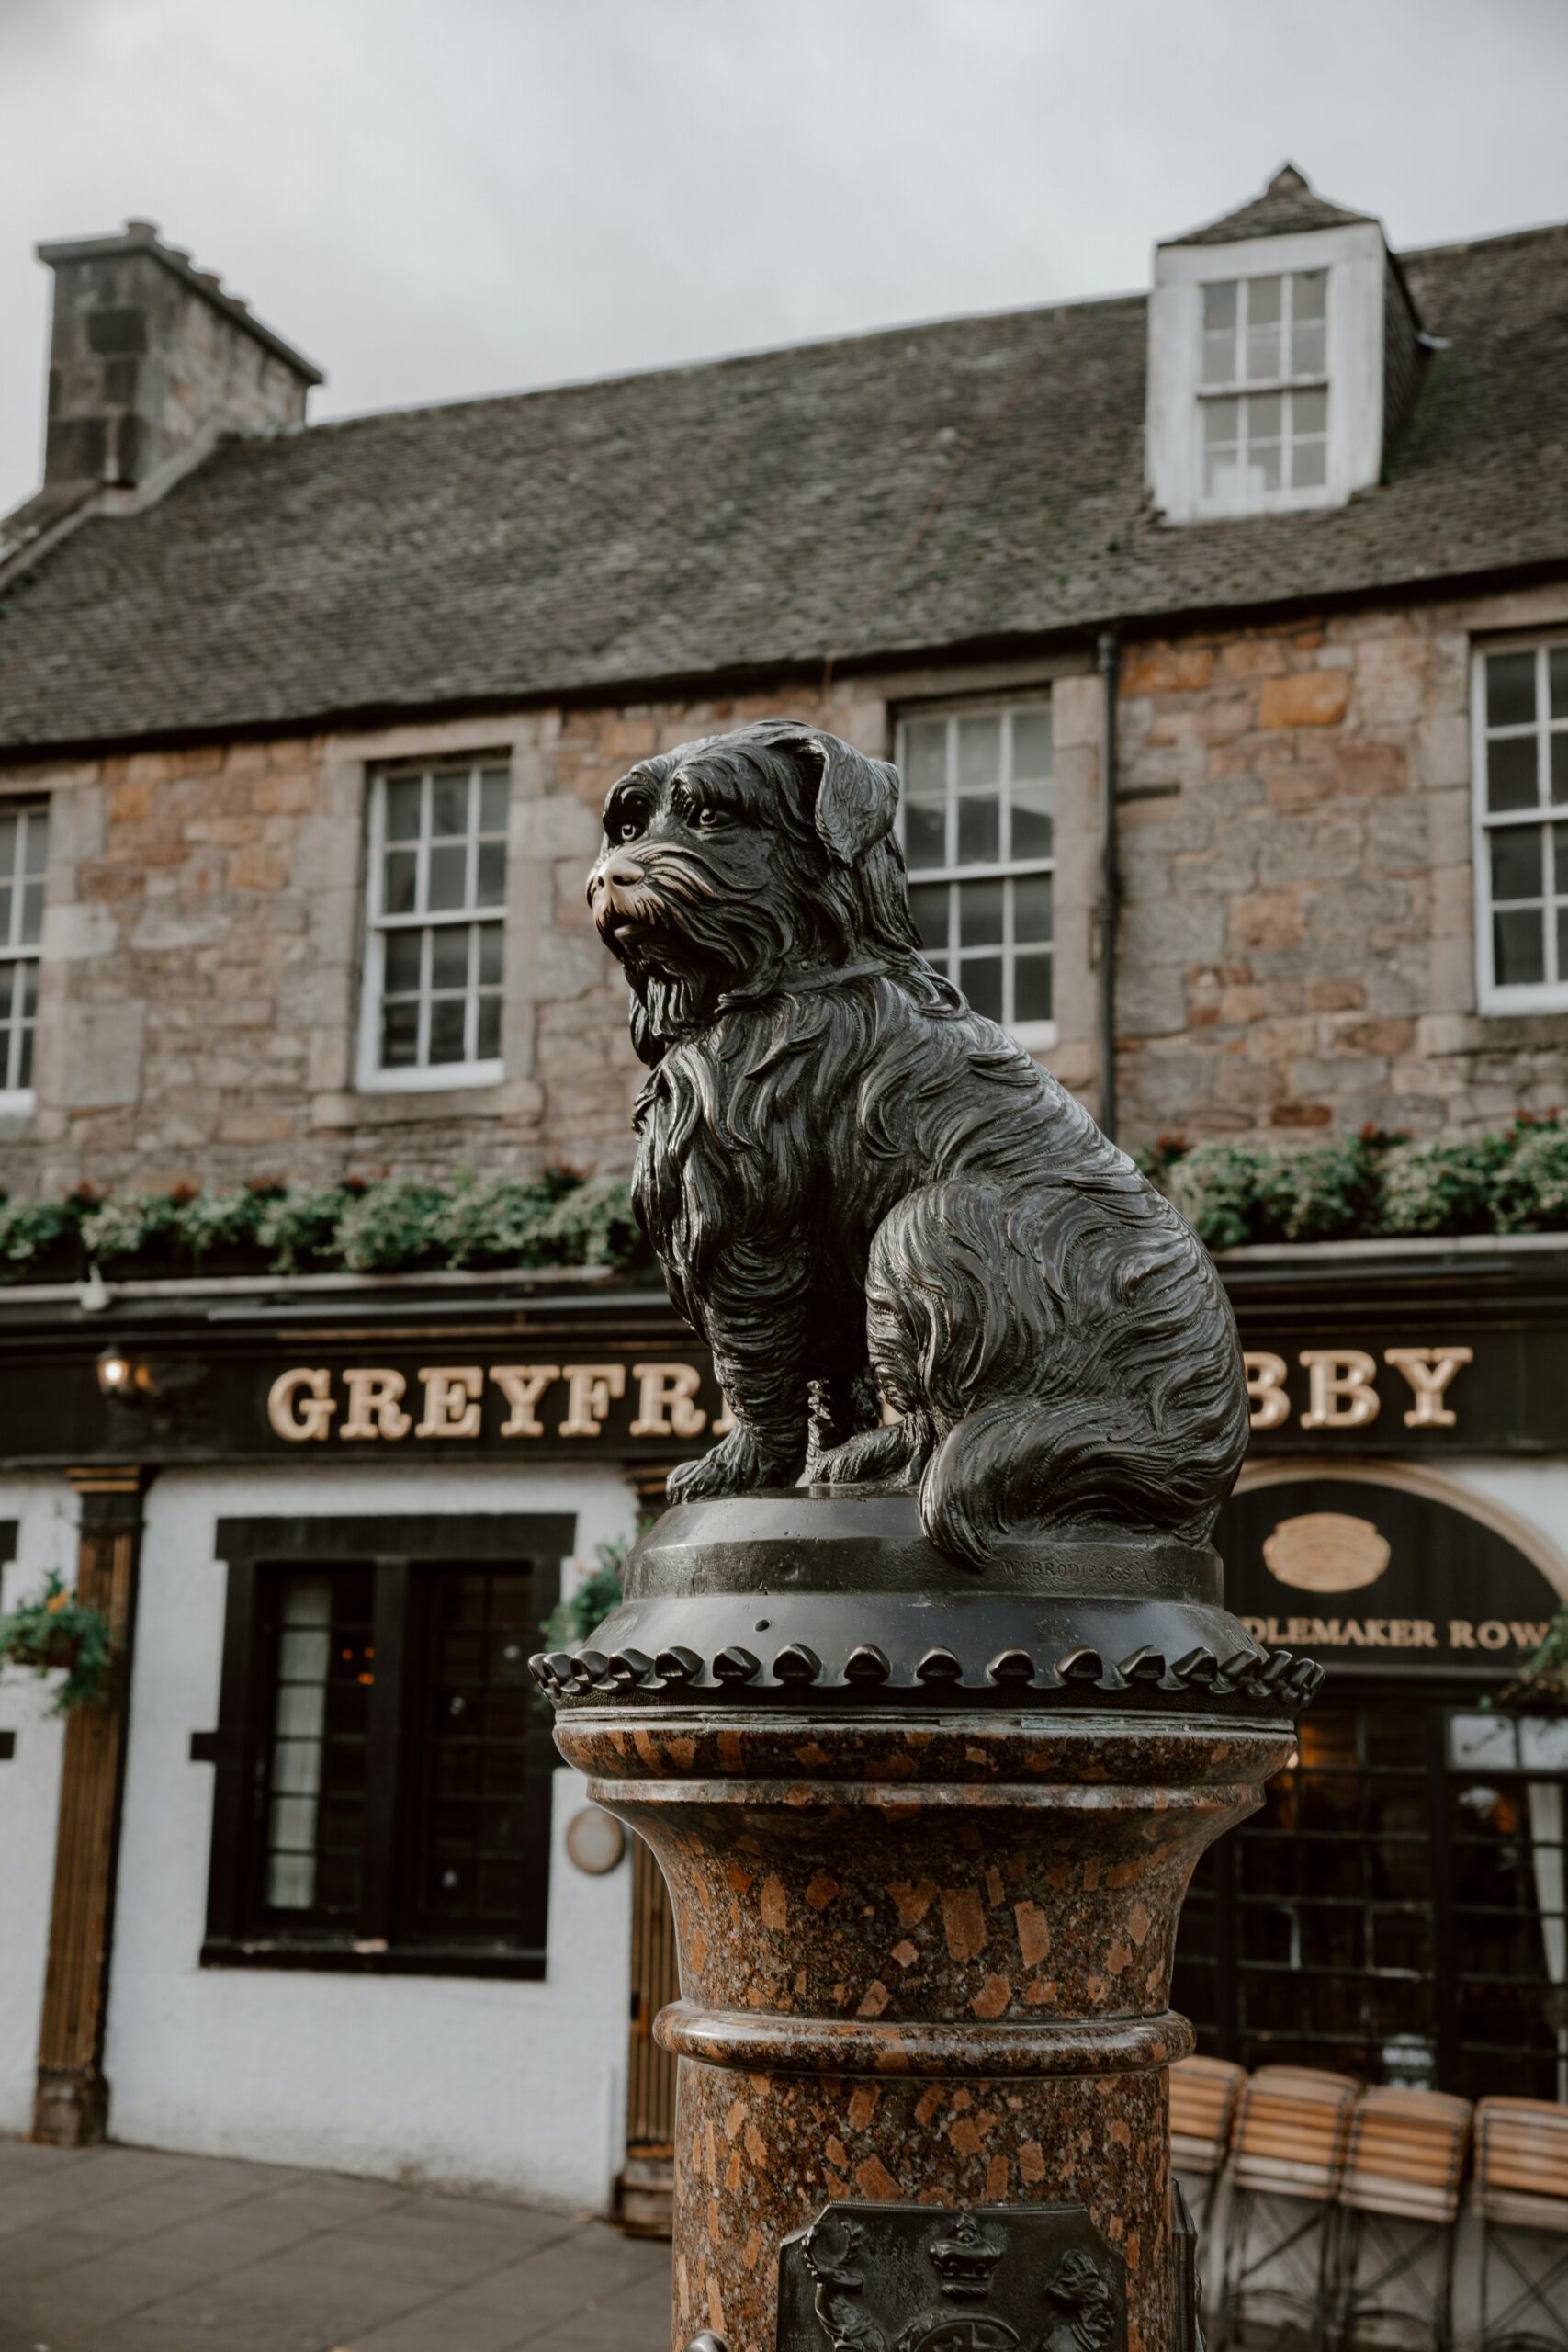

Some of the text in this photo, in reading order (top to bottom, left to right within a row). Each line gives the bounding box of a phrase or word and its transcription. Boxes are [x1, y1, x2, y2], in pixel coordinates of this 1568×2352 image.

[1244, 1347, 1473, 1429] BBY
[1240, 1616, 1551, 1650] DLEMAKER ROW
